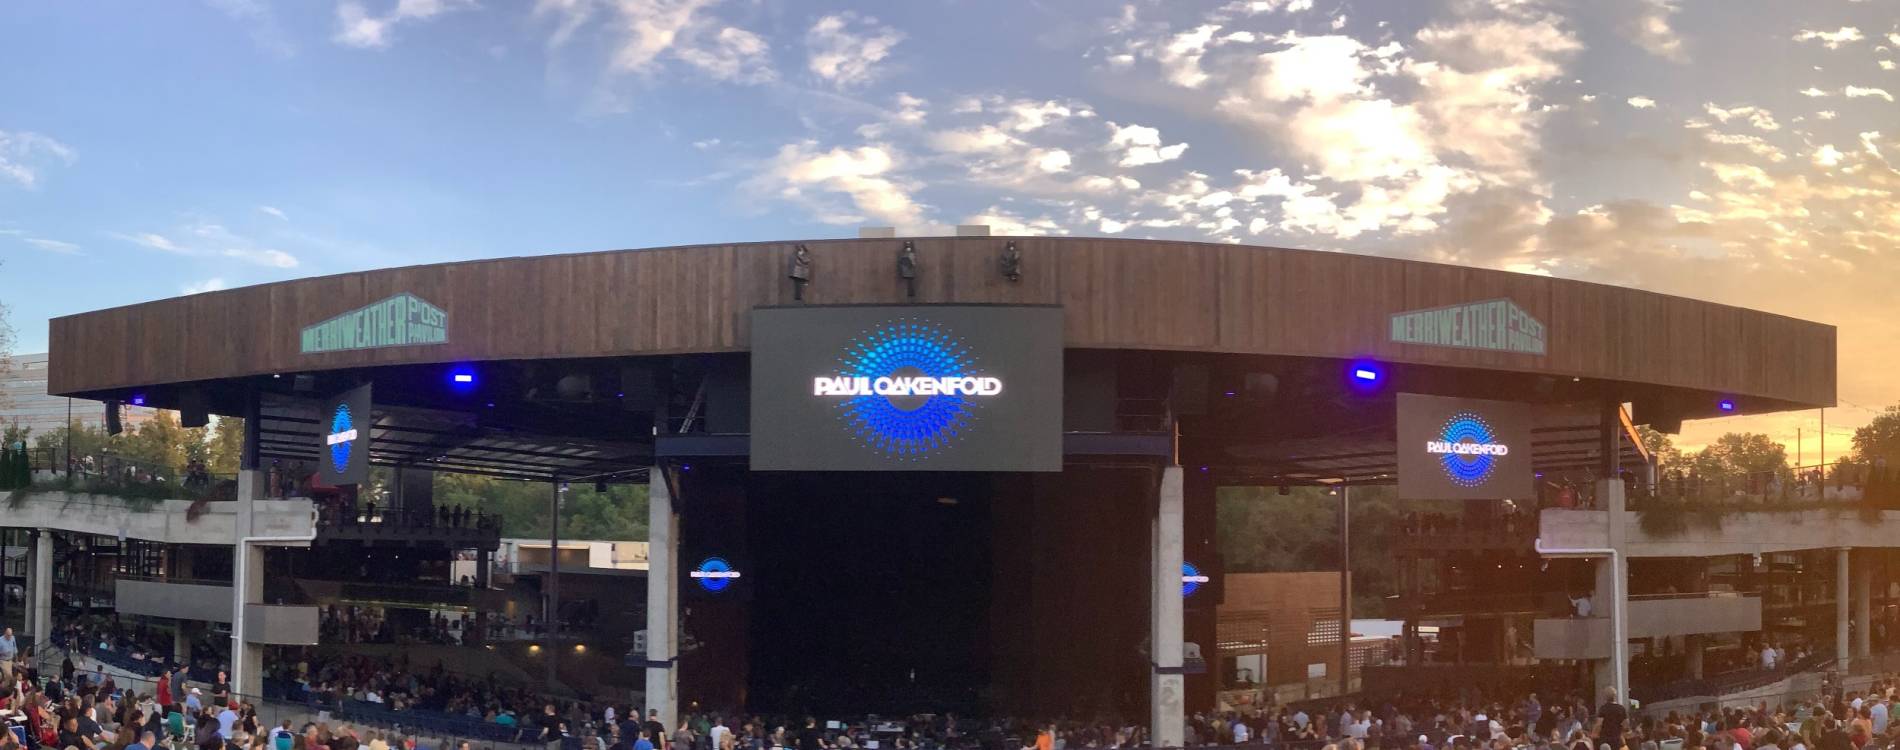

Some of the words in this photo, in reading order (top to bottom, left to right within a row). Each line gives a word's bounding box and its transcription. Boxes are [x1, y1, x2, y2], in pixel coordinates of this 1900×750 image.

[302, 296, 406, 352] MERRIWEATHER
[408, 296, 446, 327] POST
[1392, 301, 1506, 349] MERRIWEATHER
[1508, 302, 1544, 340] POST
[814, 376, 873, 396] PAUL
[873, 376, 1002, 396] OAKENFOLD
[1427, 441, 1452, 454] PAUL
[1452, 443, 1508, 456] OAKENFOLD
